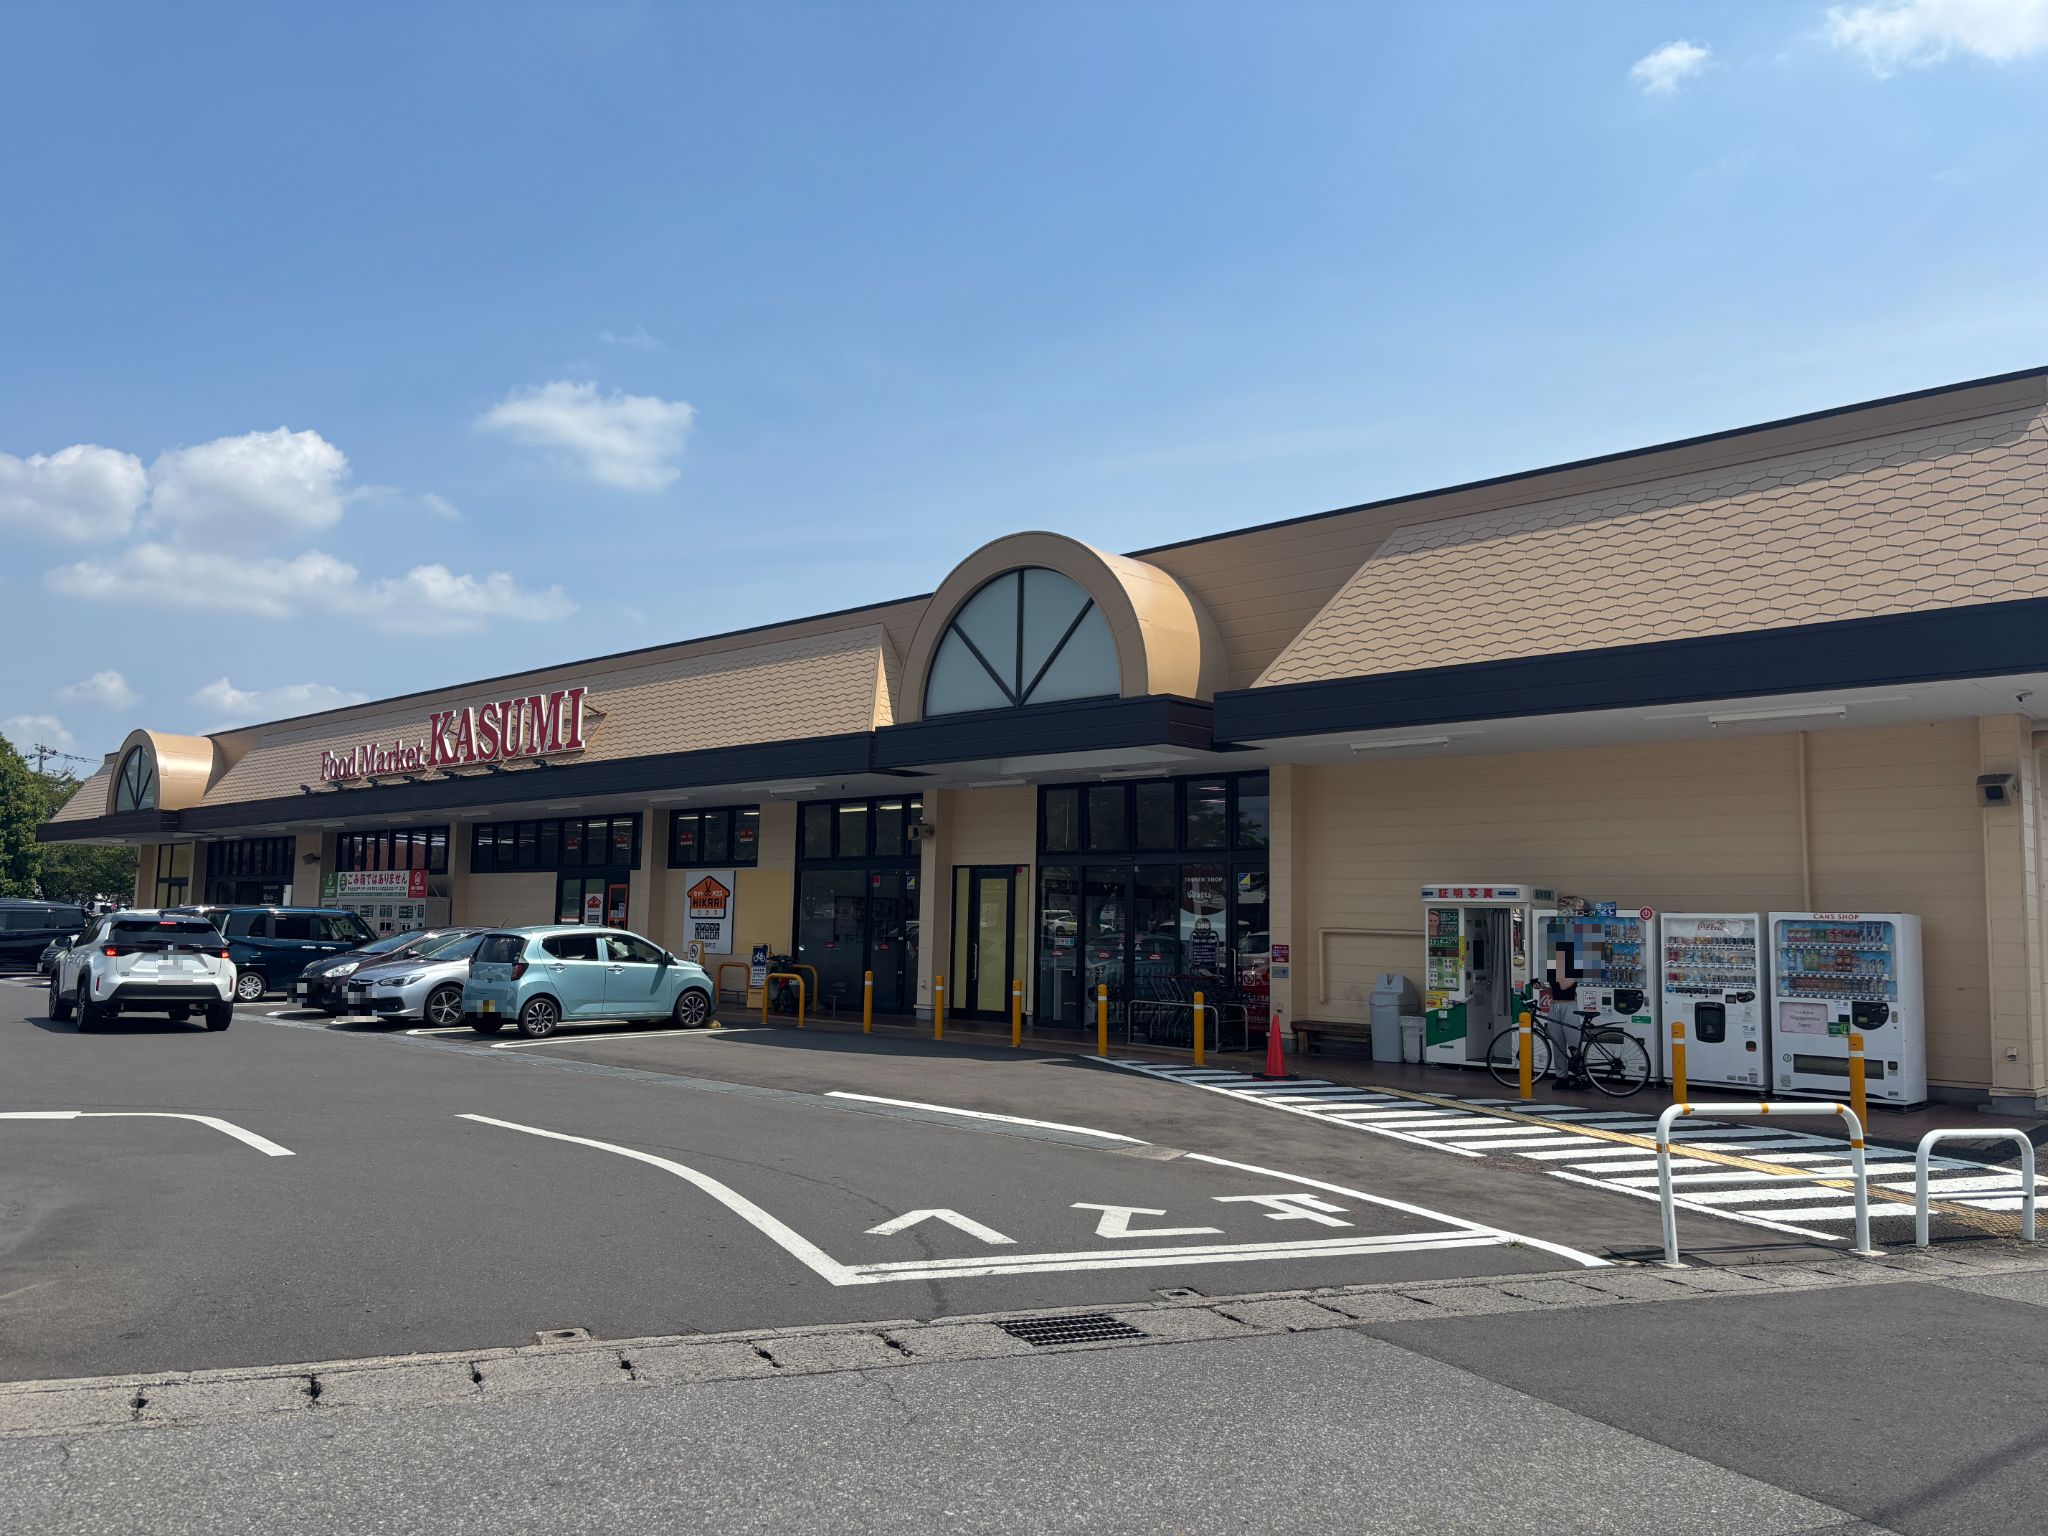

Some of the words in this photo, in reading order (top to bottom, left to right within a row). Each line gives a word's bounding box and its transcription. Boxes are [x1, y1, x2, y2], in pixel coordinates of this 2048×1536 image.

[320, 747, 358, 781] Food
[360, 739, 426, 776] Market
[428, 687, 588, 766] KASUMI
[347, 872, 407, 885] ごみ箱ではありません
[1438, 888, 1493, 898] 証明写真
[693, 897, 723, 908] HIKARI
